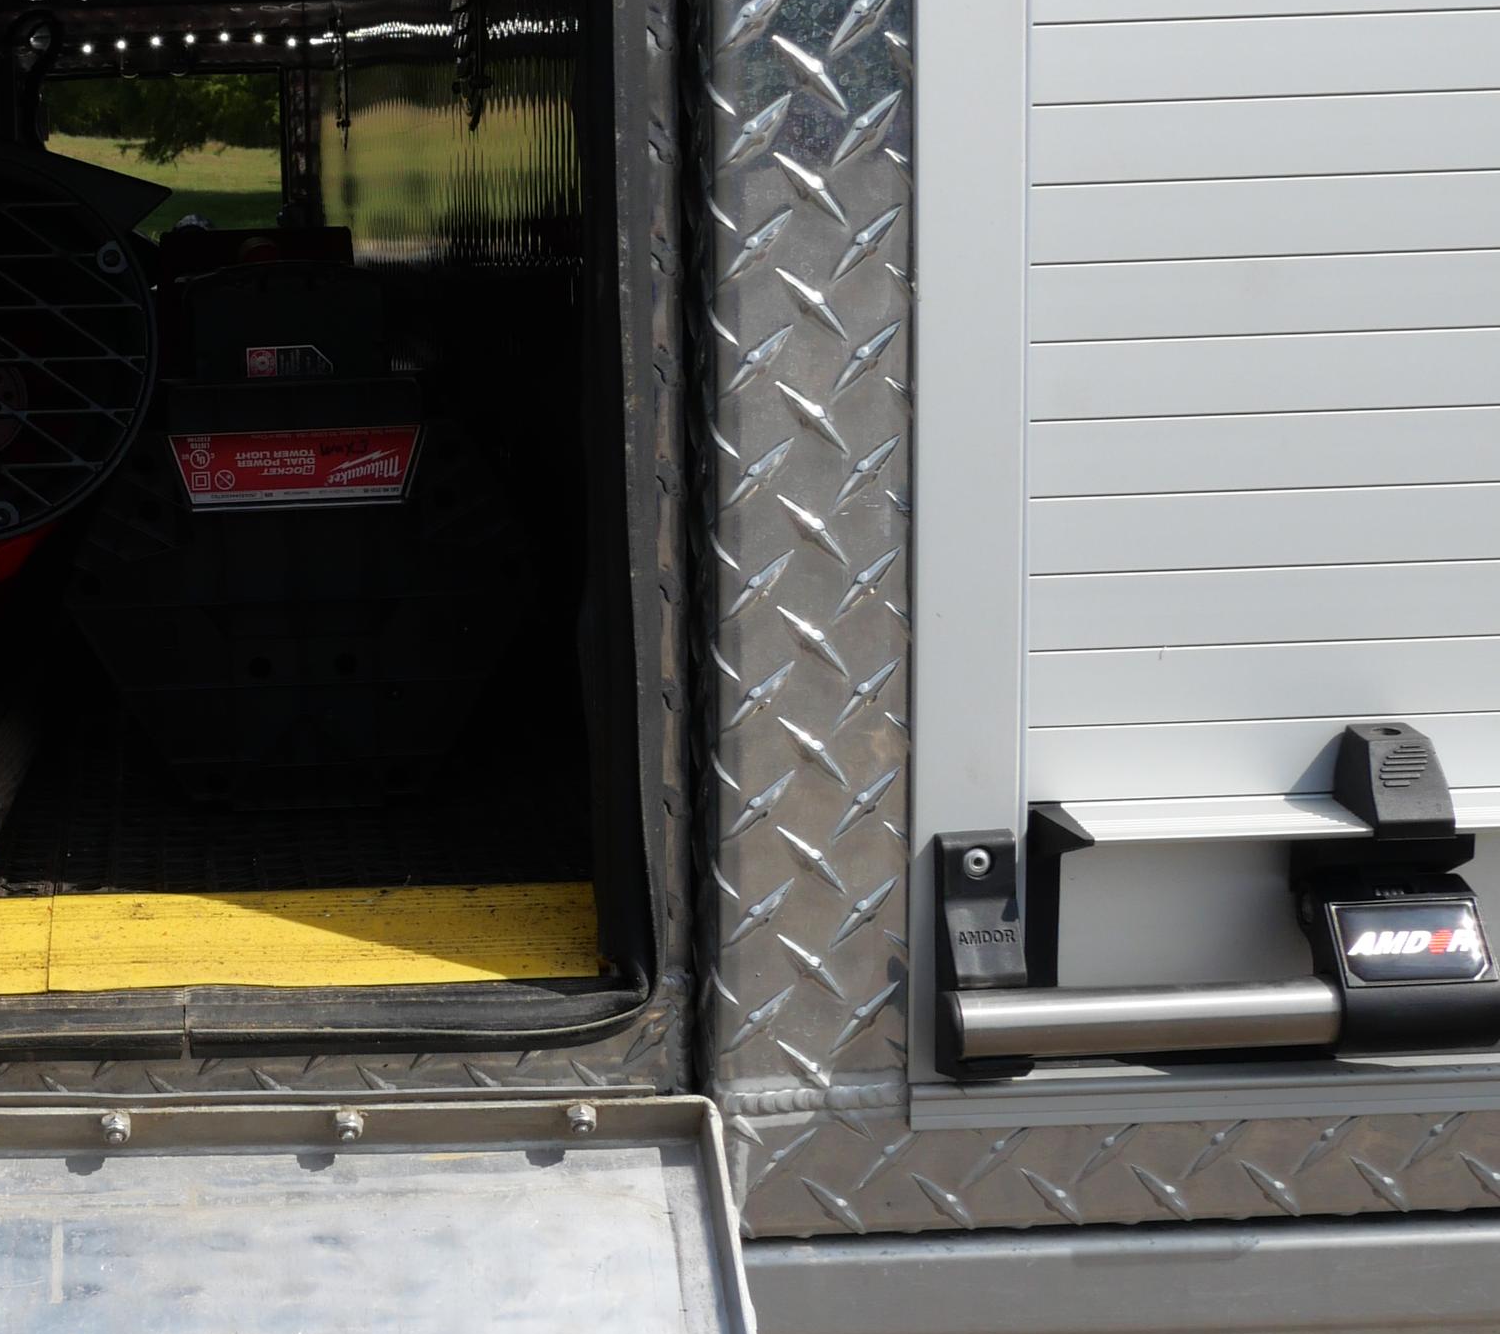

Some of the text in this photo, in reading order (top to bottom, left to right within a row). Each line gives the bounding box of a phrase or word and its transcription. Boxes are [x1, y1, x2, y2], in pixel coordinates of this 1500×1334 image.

[235, 449, 316, 459] TOWER LIGHT
[237, 457, 315, 467] DUAL POWER
[259, 465, 315, 475] ROCKET
[326, 455, 404, 485] Milwaukee
[959, 929, 1016, 945] AMDOR
[1347, 928, 1480, 956] AMDOR
